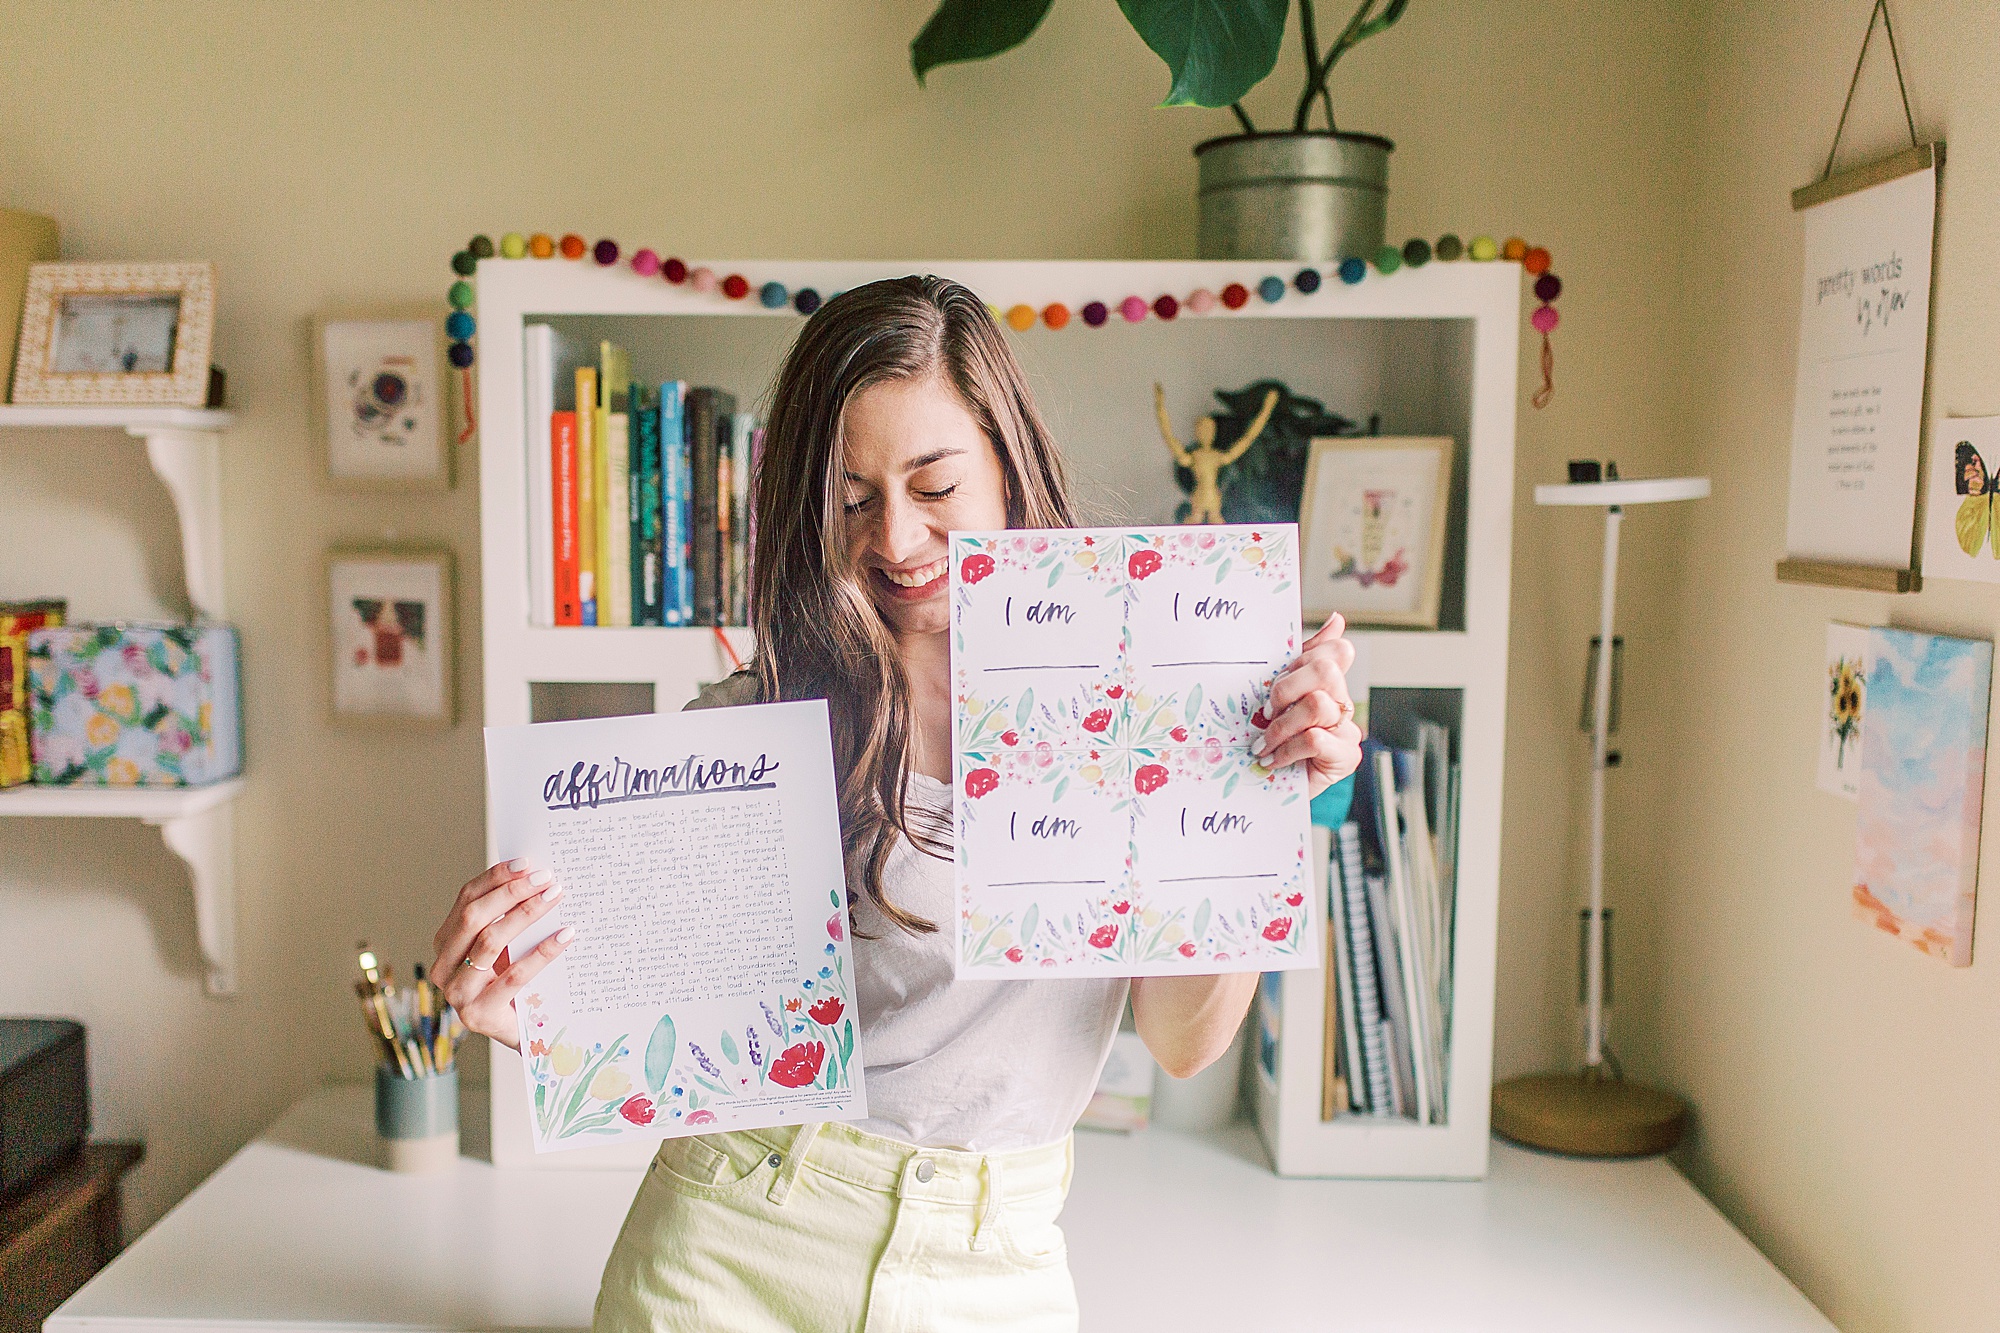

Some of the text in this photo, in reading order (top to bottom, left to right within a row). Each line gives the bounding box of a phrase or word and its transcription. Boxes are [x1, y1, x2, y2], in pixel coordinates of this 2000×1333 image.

[1006, 596, 1077, 626] I am
[1174, 592, 1245, 622] I am
[543, 754, 780, 810] affirmations
[572, 818, 591, 826] smart
[632, 810, 665, 820] beautiful
[679, 816, 686, 824] of
[1010, 810, 1083, 842] I am
[1180, 808, 1253, 836] I am
[560, 846, 578, 856] good
[643, 836, 674, 847] grateful
[744, 827, 783, 836] difference
[564, 835, 594, 844] talented
[631, 829, 667, 838] intelligent
[566, 863, 593, 872] present
[671, 854, 690, 863] great
[743, 845, 776, 855] prepared
[585, 853, 611, 861] capable
[713, 838, 750, 848] respectful
[625, 875, 652, 884] present
[732, 865, 751, 874] great
[647, 864, 676, 873] defined
[680, 864, 688, 872] by
[706, 859, 720, 868] past
[571, 888, 604, 898] prepared
[628, 885, 640, 894] get
[558, 900, 592, 911] strengths
[637, 892, 657, 903] joyful
[624, 902, 641, 911] build
[675, 905, 700, 914] invited
[594, 923, 628, 931] self-love
[732, 908, 782, 920] compassionate
[662, 925, 682, 934] stand
[716, 919, 737, 929] myself
[773, 914, 792, 922] loved
[669, 933, 701, 941] authentic
[776, 941, 795, 950] great
[637, 943, 678, 954] determined
[590, 975, 625, 984] treasured
[660, 968, 685, 977] wanted
[737, 961, 775, 970] boundaries
[638, 962, 679, 972] perspective
[693, 956, 726, 965] important
[601, 984, 626, 992] allowed
[727, 970, 748, 981] myself
[771, 967, 797, 978] respect
[604, 993, 629, 1002] patient
[670, 985, 694, 994] allowed
[665, 994, 693, 1003] attitude
[728, 988, 755, 997] resilient
